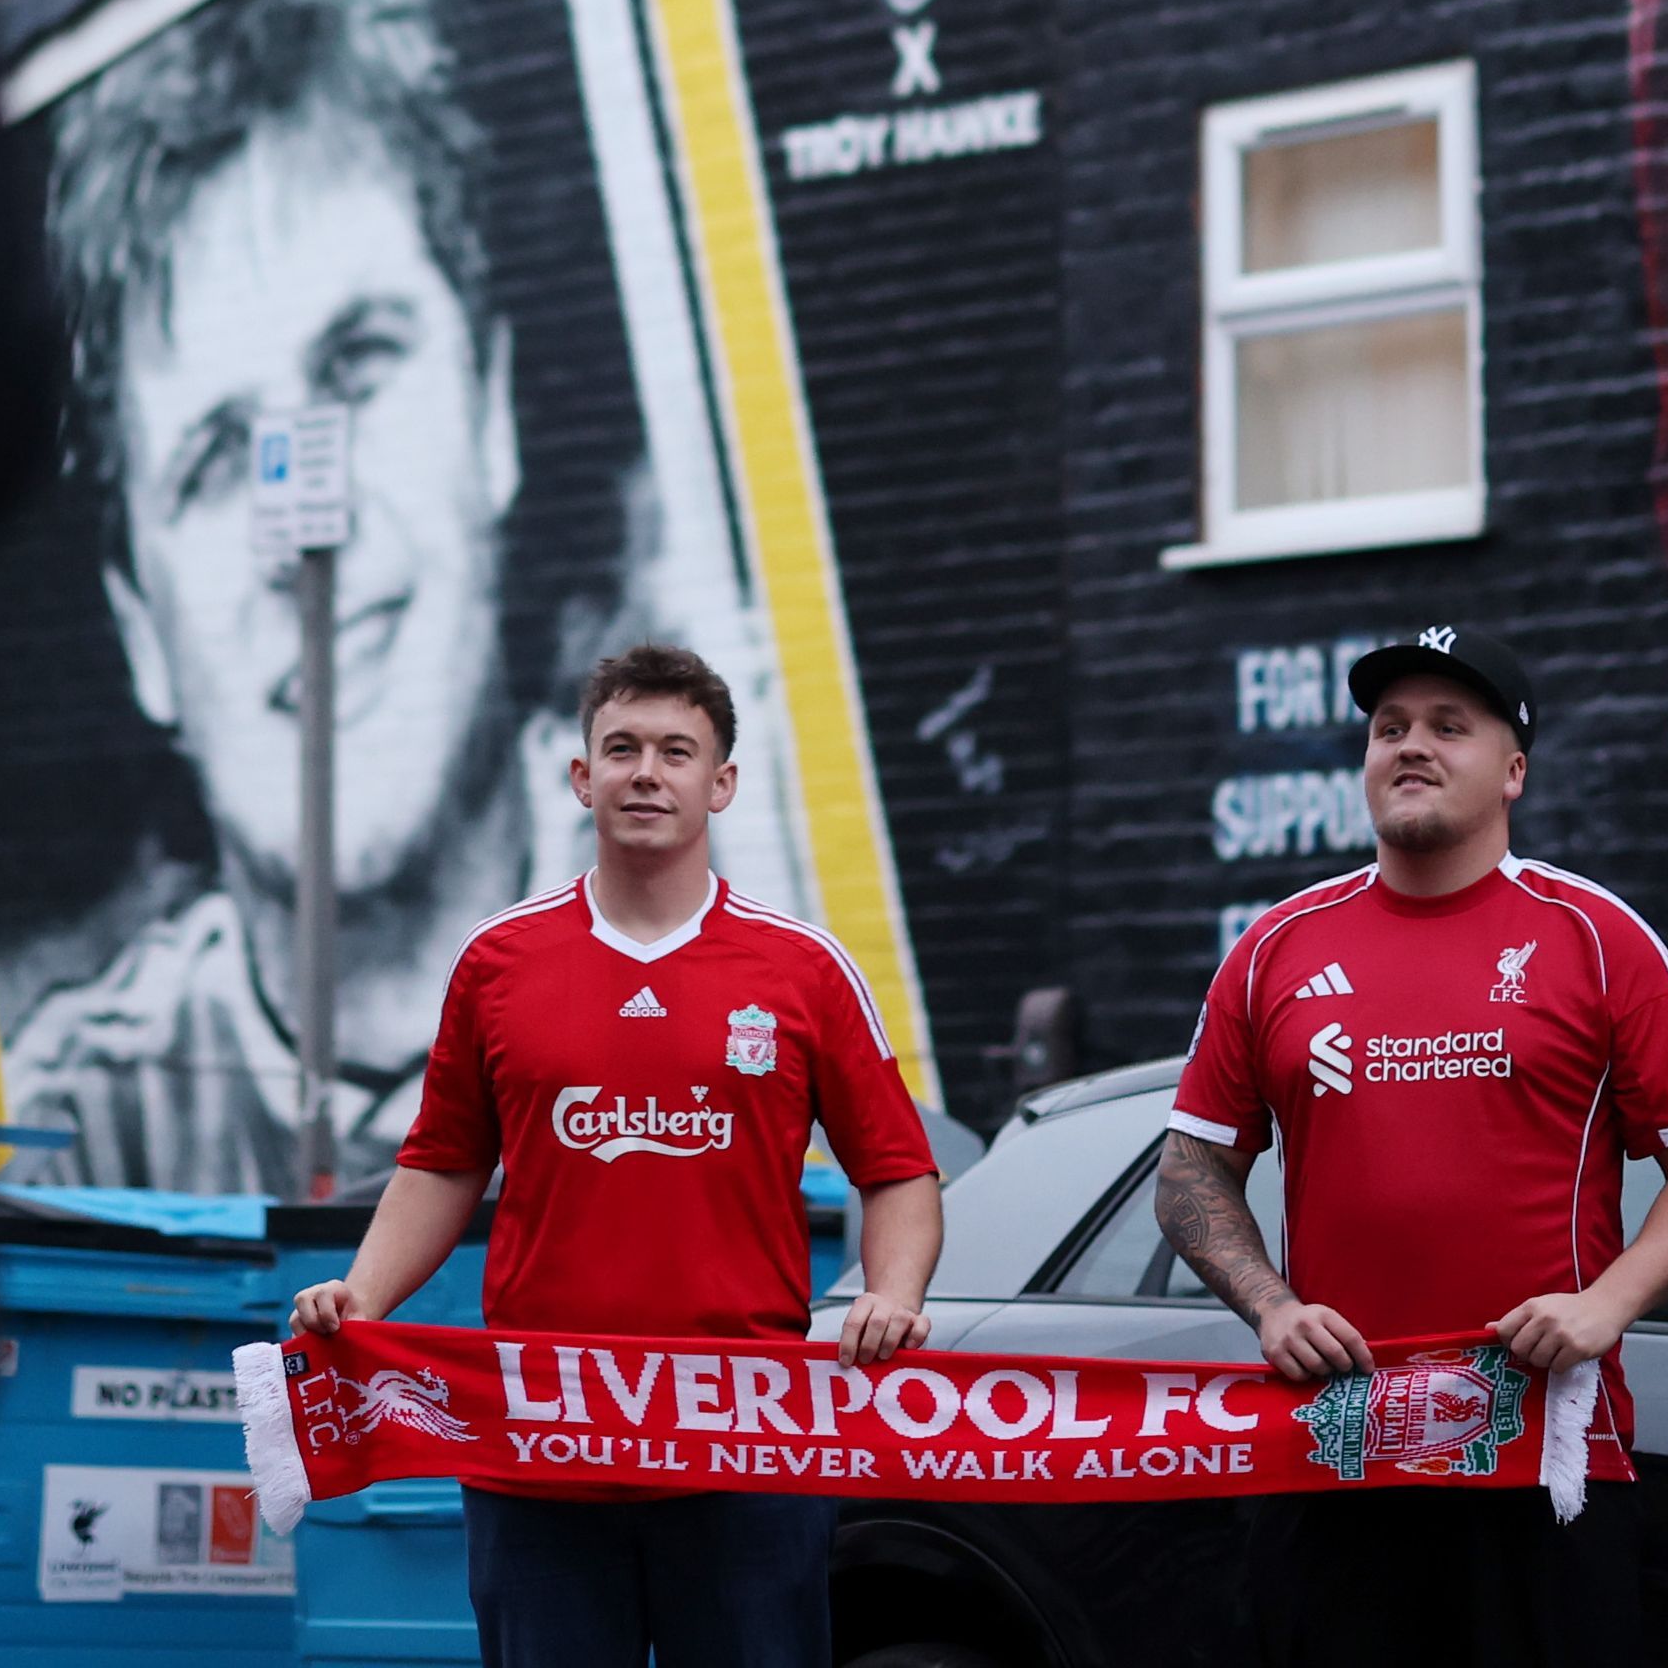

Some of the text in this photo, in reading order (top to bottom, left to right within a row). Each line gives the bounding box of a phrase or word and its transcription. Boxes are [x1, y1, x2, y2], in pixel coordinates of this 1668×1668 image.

[891, 20, 942, 99] X
[1418, 626, 1457, 654] NY
[1239, 647, 1325, 732] FOR
[618, 1006, 668, 1018] adidas
[1489, 988, 1527, 1004] L.F.C.
[1365, 1028, 1504, 1058] standard
[1365, 1053, 1512, 1082] chartered
[552, 1086, 734, 1163] Carlsberg
[97, 1383, 142, 1406] NO
[297, 1371, 341, 1456] L.F.C.
[493, 1341, 1266, 1439] LIVERPOOL FC
[1382, 1373, 1412, 1450] LIVERPOOL
[507, 1432, 1254, 1480] YOU'LL NEVER WALK ALONE
